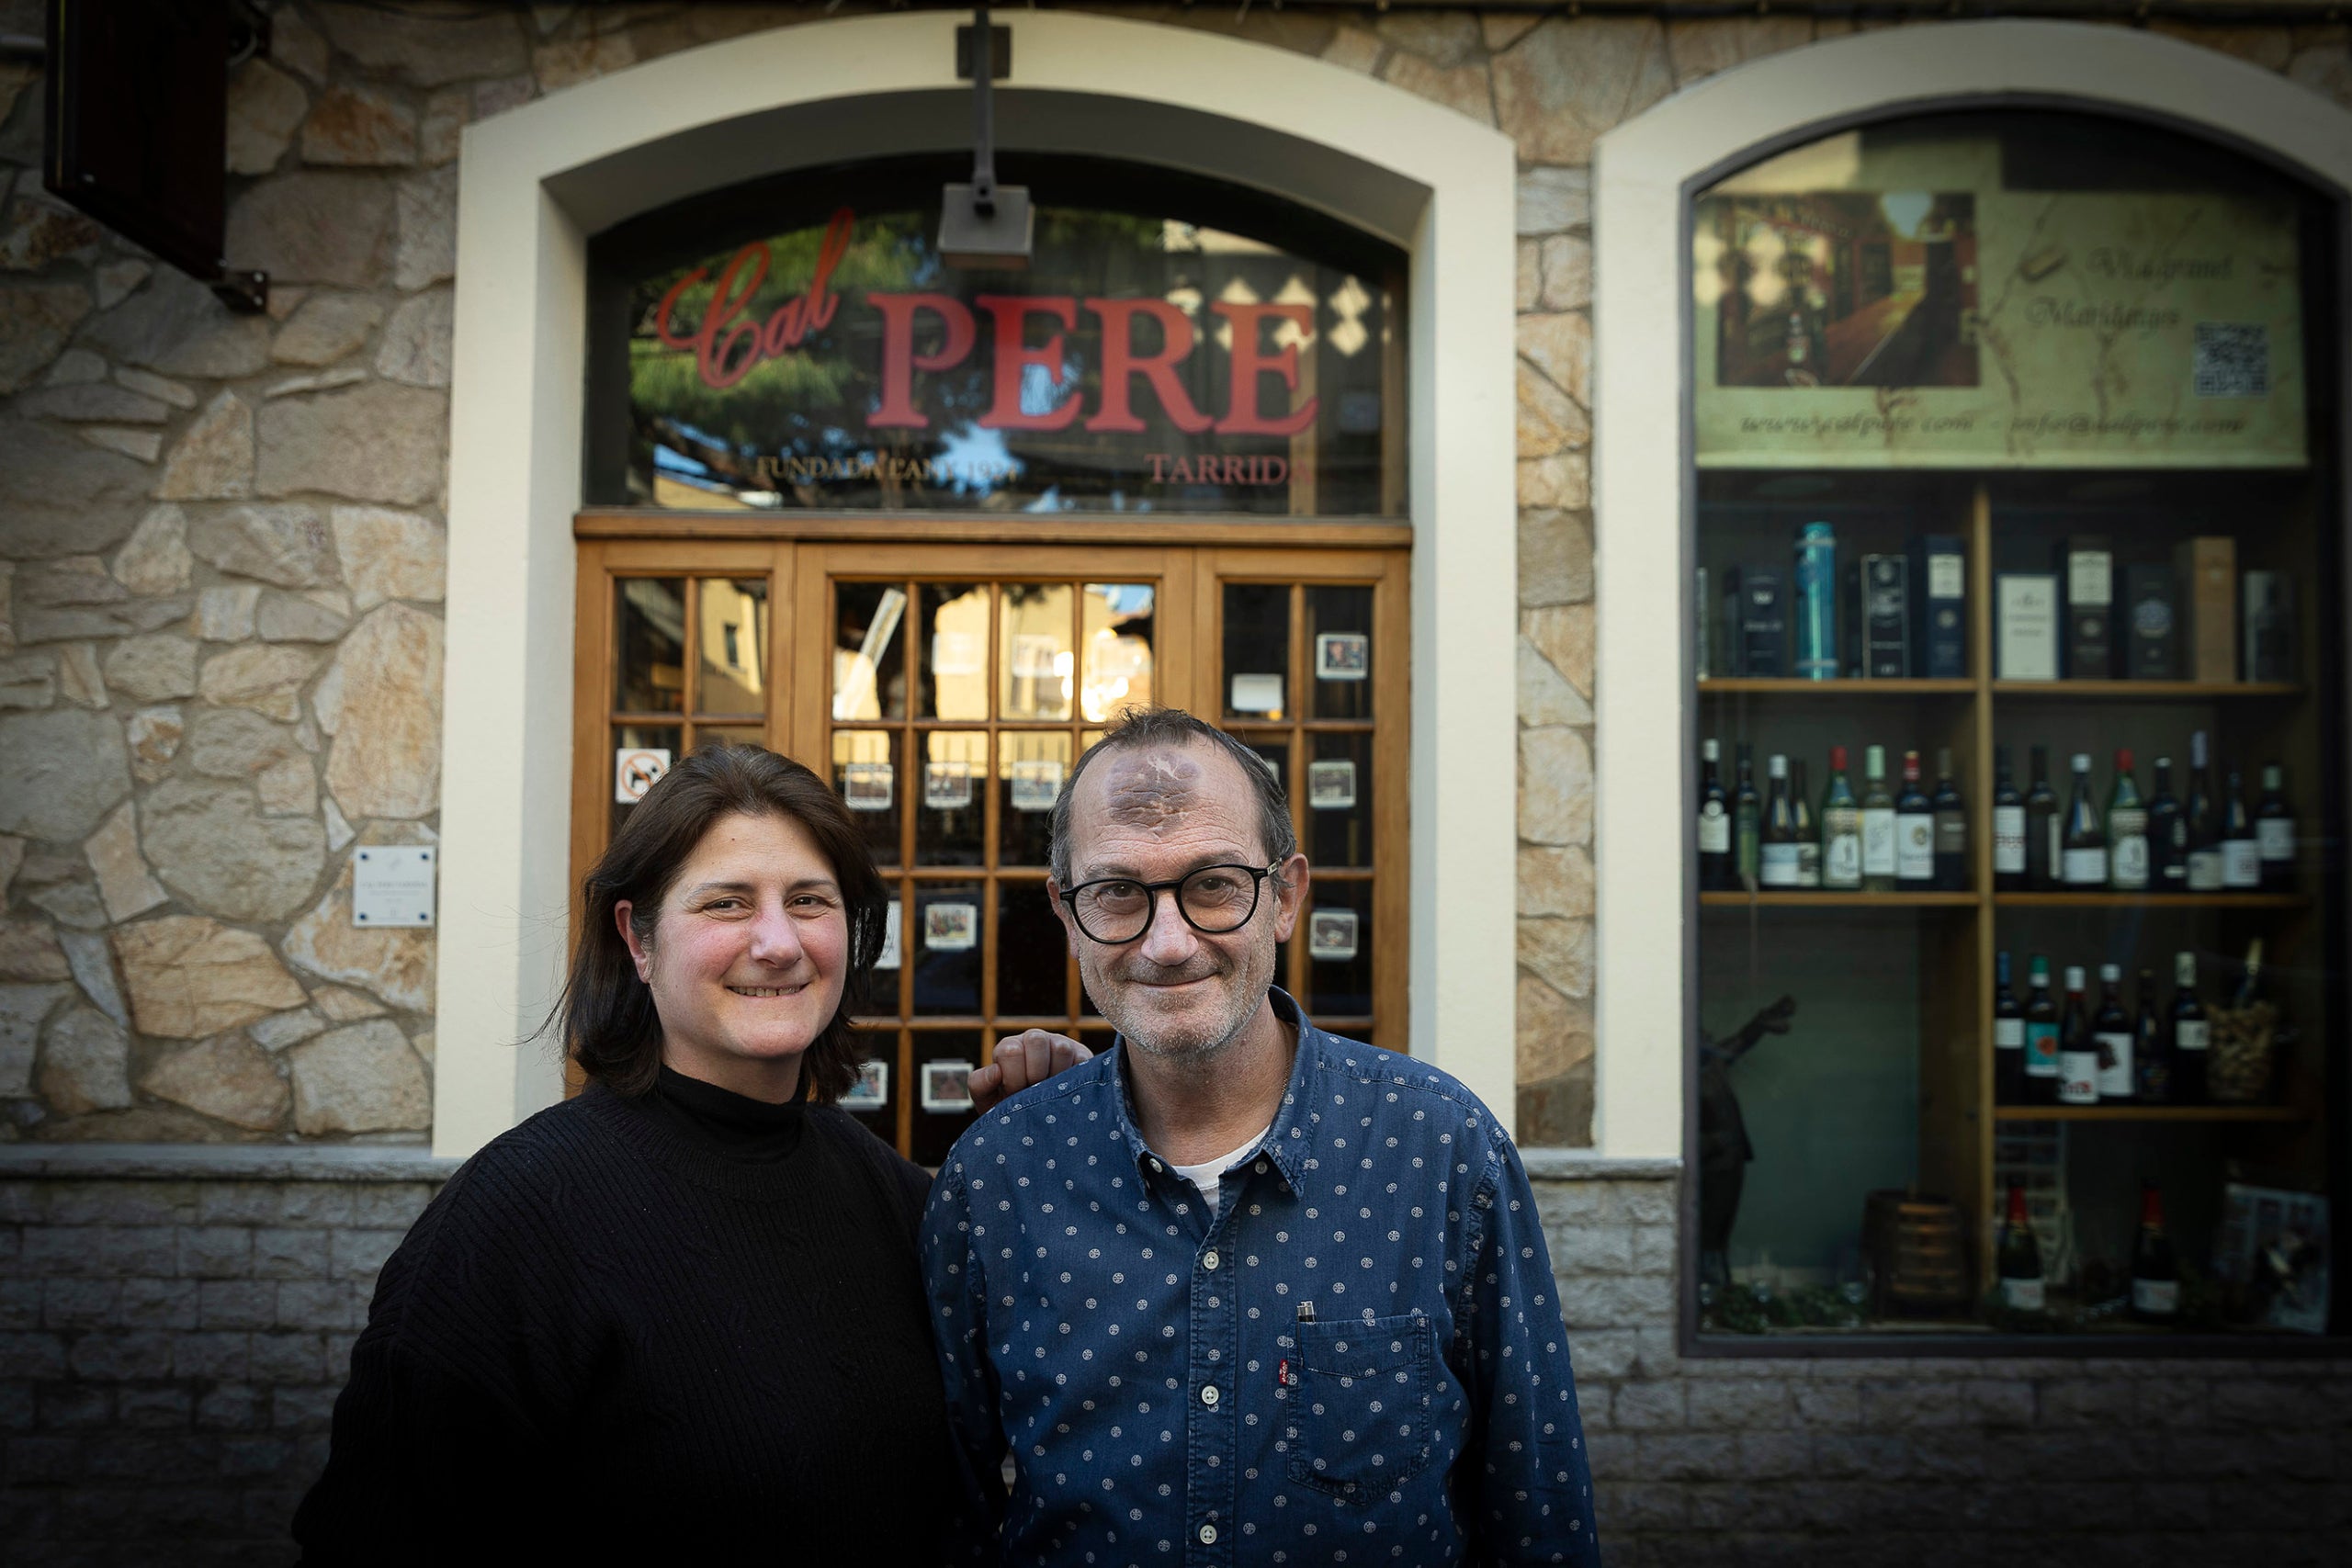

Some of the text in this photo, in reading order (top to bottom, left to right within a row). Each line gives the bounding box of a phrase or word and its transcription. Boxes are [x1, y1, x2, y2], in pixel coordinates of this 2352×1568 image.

[656, 206, 1319, 437] Cal PERE
[755, 456, 879, 480] FUNDADA
[1145, 454, 1312, 485] TARRIDA
